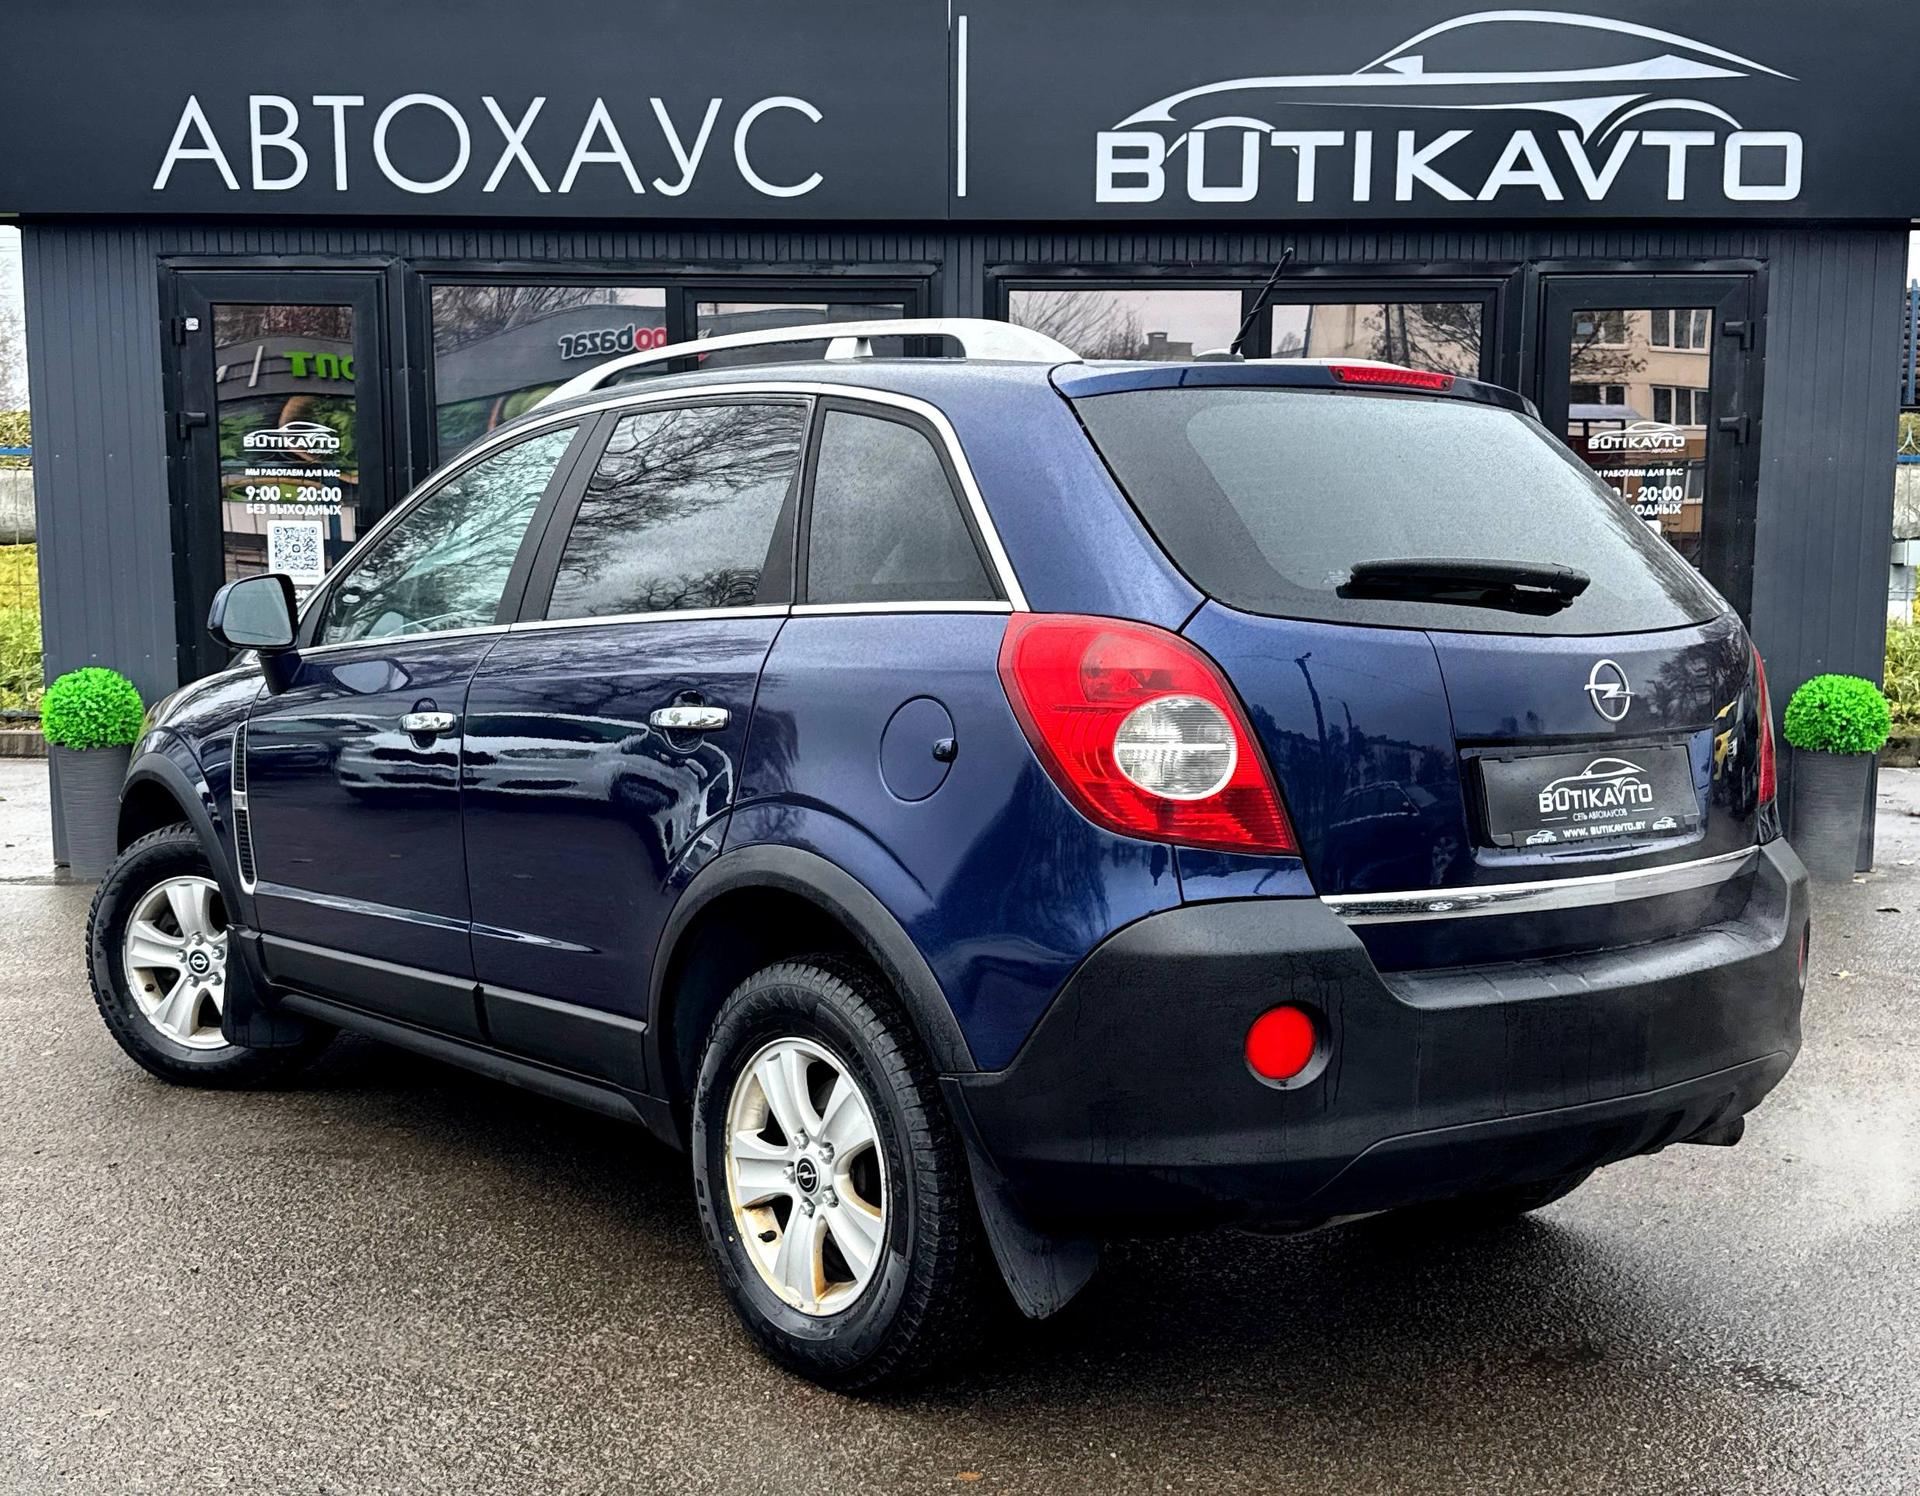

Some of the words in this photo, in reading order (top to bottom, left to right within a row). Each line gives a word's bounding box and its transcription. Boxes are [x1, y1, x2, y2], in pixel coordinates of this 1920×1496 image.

[153, 94, 824, 198] АВТОХАУС
[1096, 130, 1804, 203] BUTIKAVTO
[243, 436, 340, 449] BUTIKAVTO
[1588, 436, 1685, 449] BUTIKAVTO
[245, 468, 260, 476] МЫ
[261, 468, 304, 477] РАБОТАЕМ
[305, 469, 322, 478] ДЛЯ
[323, 469, 341, 477] ВАС
[1603, 469, 1646, 478] РАБОТАЕМ
[1647, 468, 1664, 477] ДЛЯ
[1666, 468, 1684, 476] ВАС
[245, 486, 280, 501] 9:00
[296, 487, 342, 501] 20:00
[1637, 485, 1683, 502] 20:00
[246, 504, 266, 514] БЕЗ
[269, 504, 342, 516] ВЫХОДНЫХ
[1538, 784, 1653, 813] BUTIKAVTO
[1562, 827, 1588, 838] WWW.
